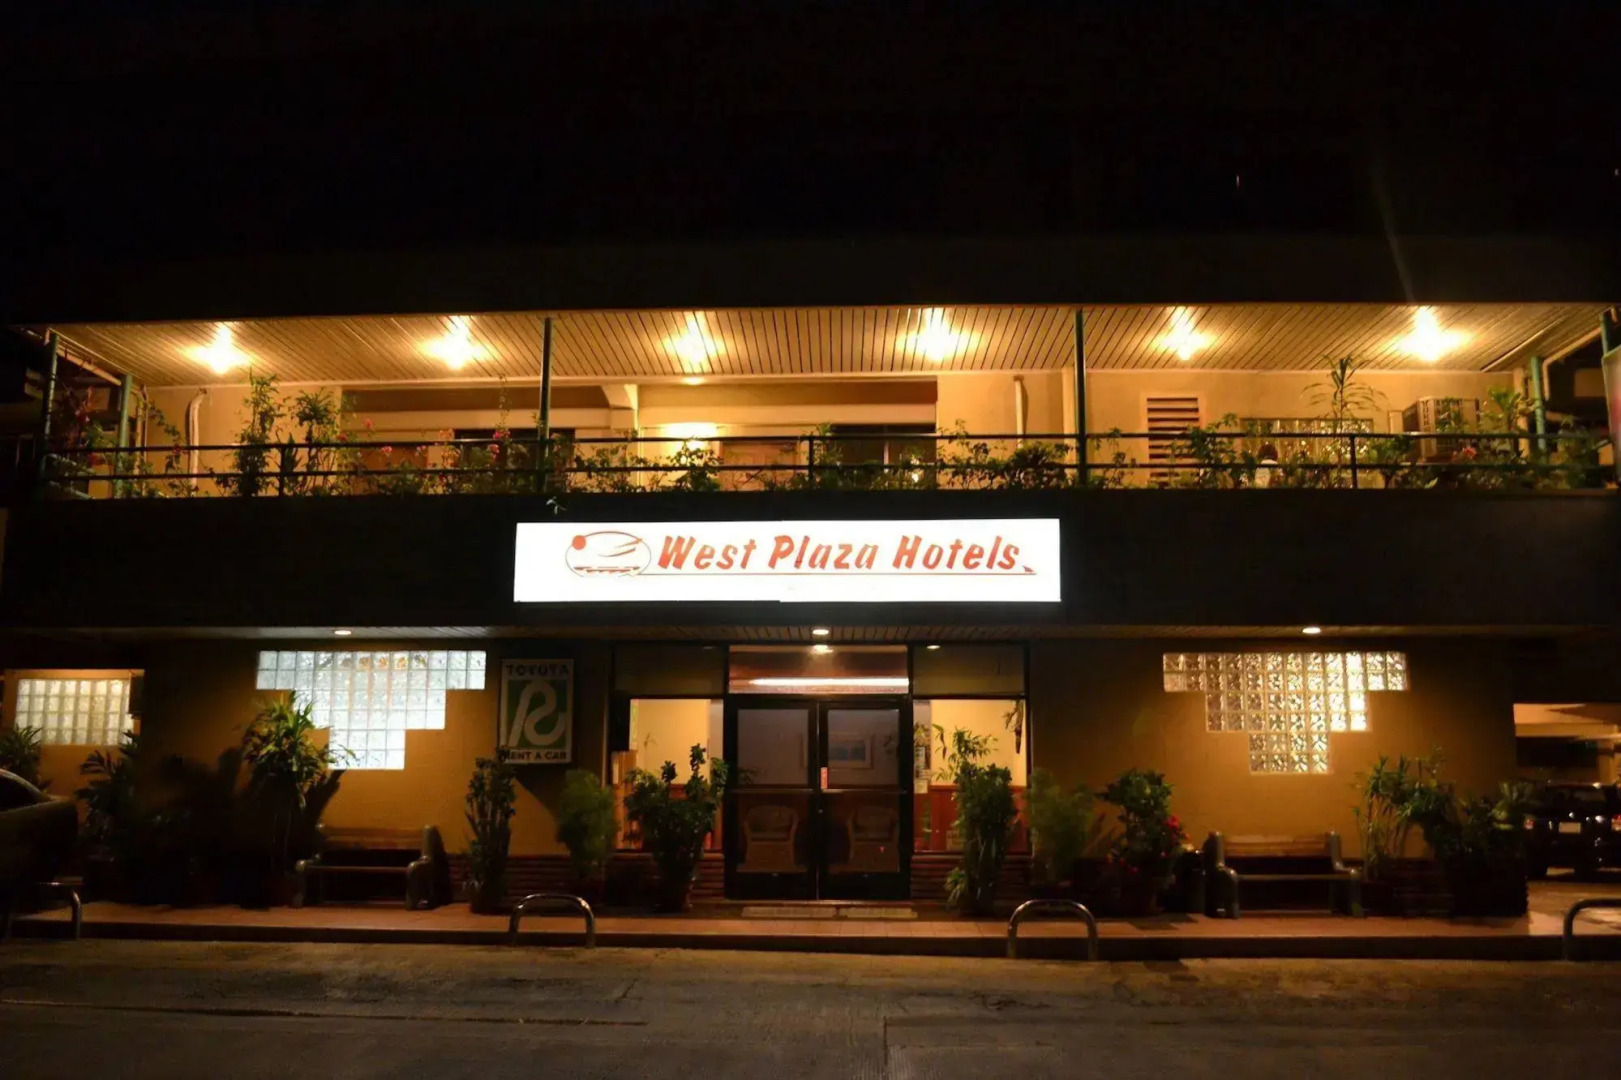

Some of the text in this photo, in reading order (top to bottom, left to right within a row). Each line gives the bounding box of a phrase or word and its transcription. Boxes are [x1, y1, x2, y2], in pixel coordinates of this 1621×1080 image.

[658, 534, 1020, 570] West Plaza Hotels
[506, 664, 569, 676] TOYOTA
[535, 751, 542, 760] A
[545, 751, 567, 760] CAR
